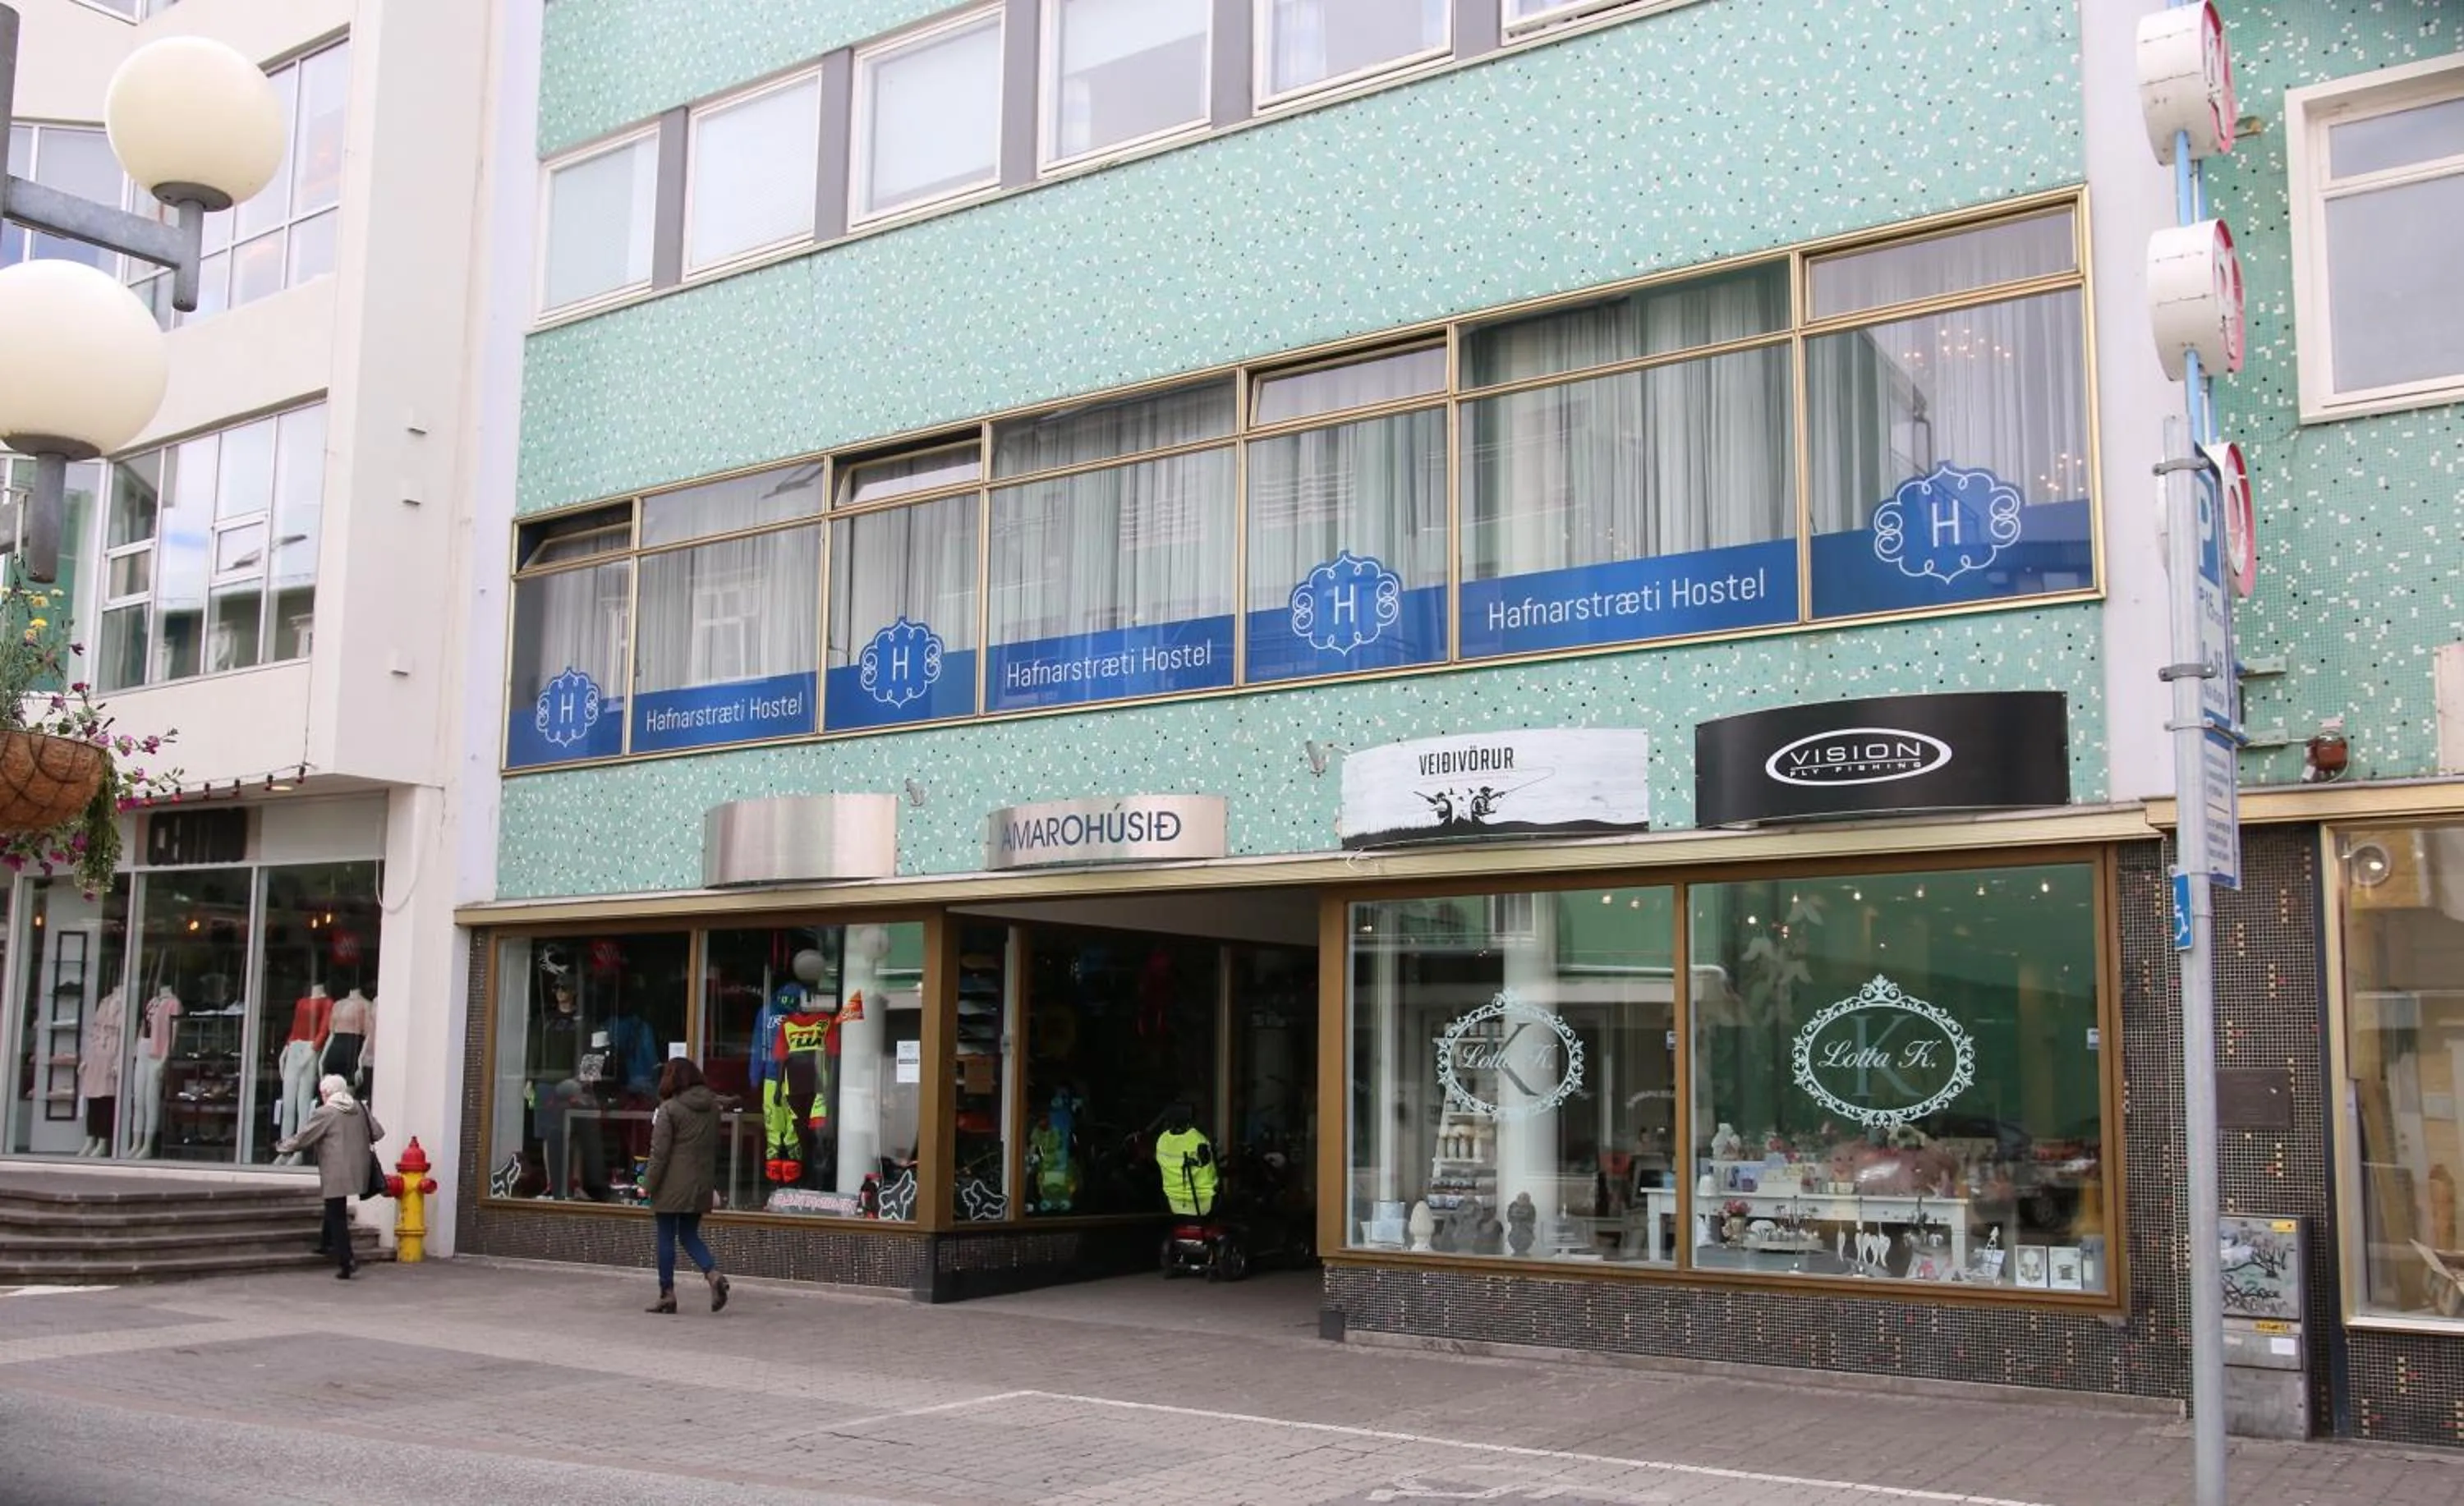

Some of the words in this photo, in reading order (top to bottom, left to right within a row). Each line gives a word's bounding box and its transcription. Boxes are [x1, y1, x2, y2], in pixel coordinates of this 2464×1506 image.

[1931, 499, 1961, 548] H
[1332, 584, 1354, 625] H
[1487, 581, 1661, 631] Hafnarstræti
[1671, 567, 1765, 609] Hostel
[892, 645, 909, 682] H
[1007, 648, 1135, 688] Hafnarstræti
[1142, 639, 1211, 673] Hostel
[560, 692, 574, 724] H
[646, 700, 745, 732] Hafnarstræti
[749, 691, 802, 721] Hostel
[1418, 745, 1515, 776] VEIÐIVÖRUR
[1790, 741, 1921, 766] VISION
[1790, 768, 1821, 778] FLY
[1835, 760, 1922, 774] FISHING
[1000, 802, 1182, 853] AMAROHÚSIÐ
[1817, 1039, 1891, 1068] Lotta
